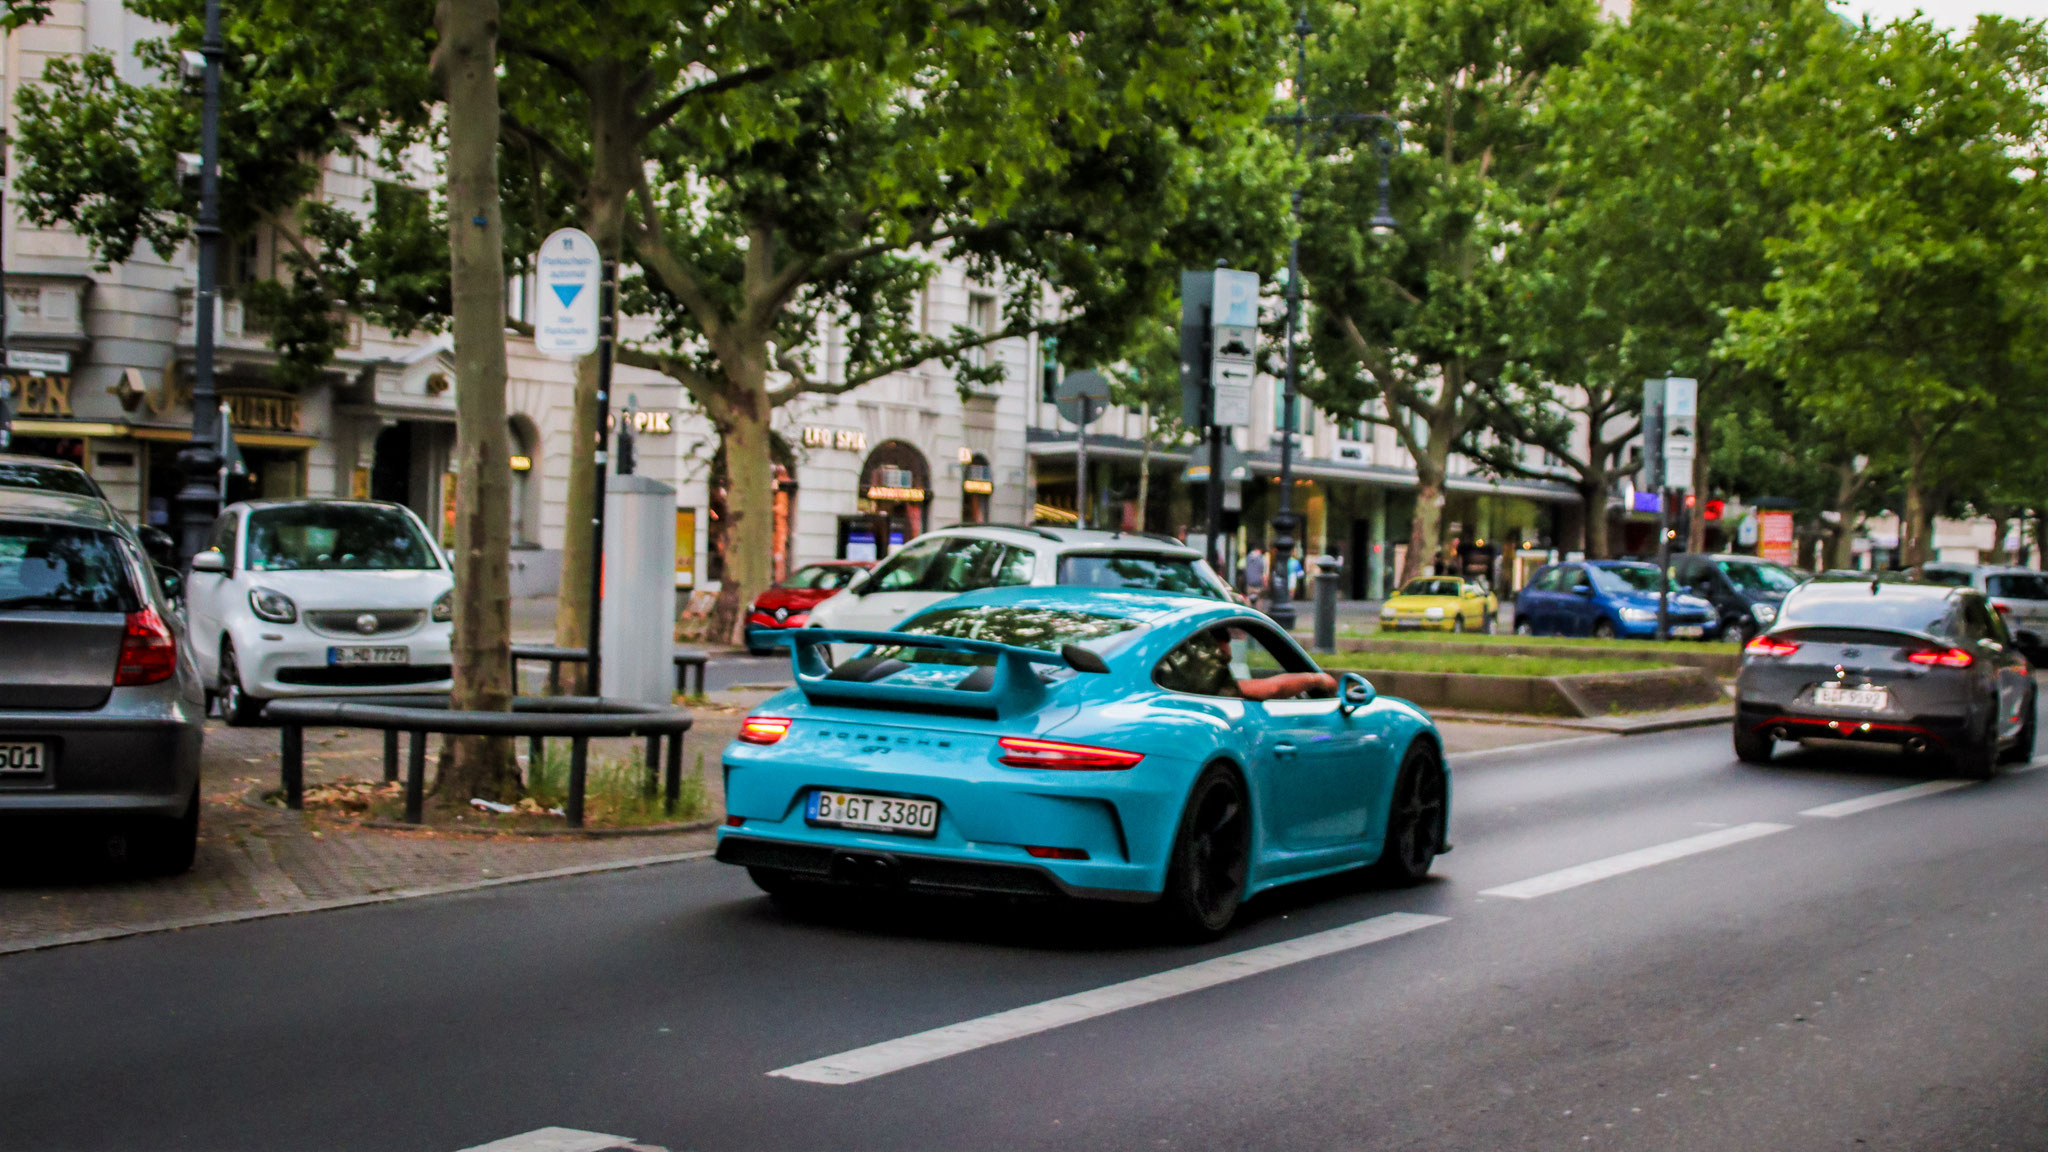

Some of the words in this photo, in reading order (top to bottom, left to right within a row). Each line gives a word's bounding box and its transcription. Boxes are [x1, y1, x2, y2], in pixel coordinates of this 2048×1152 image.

[818, 730, 951, 748] PORSCHE
[819, 795, 832, 817] B
[846, 798, 874, 820] GT
[879, 800, 932, 827] 3380
